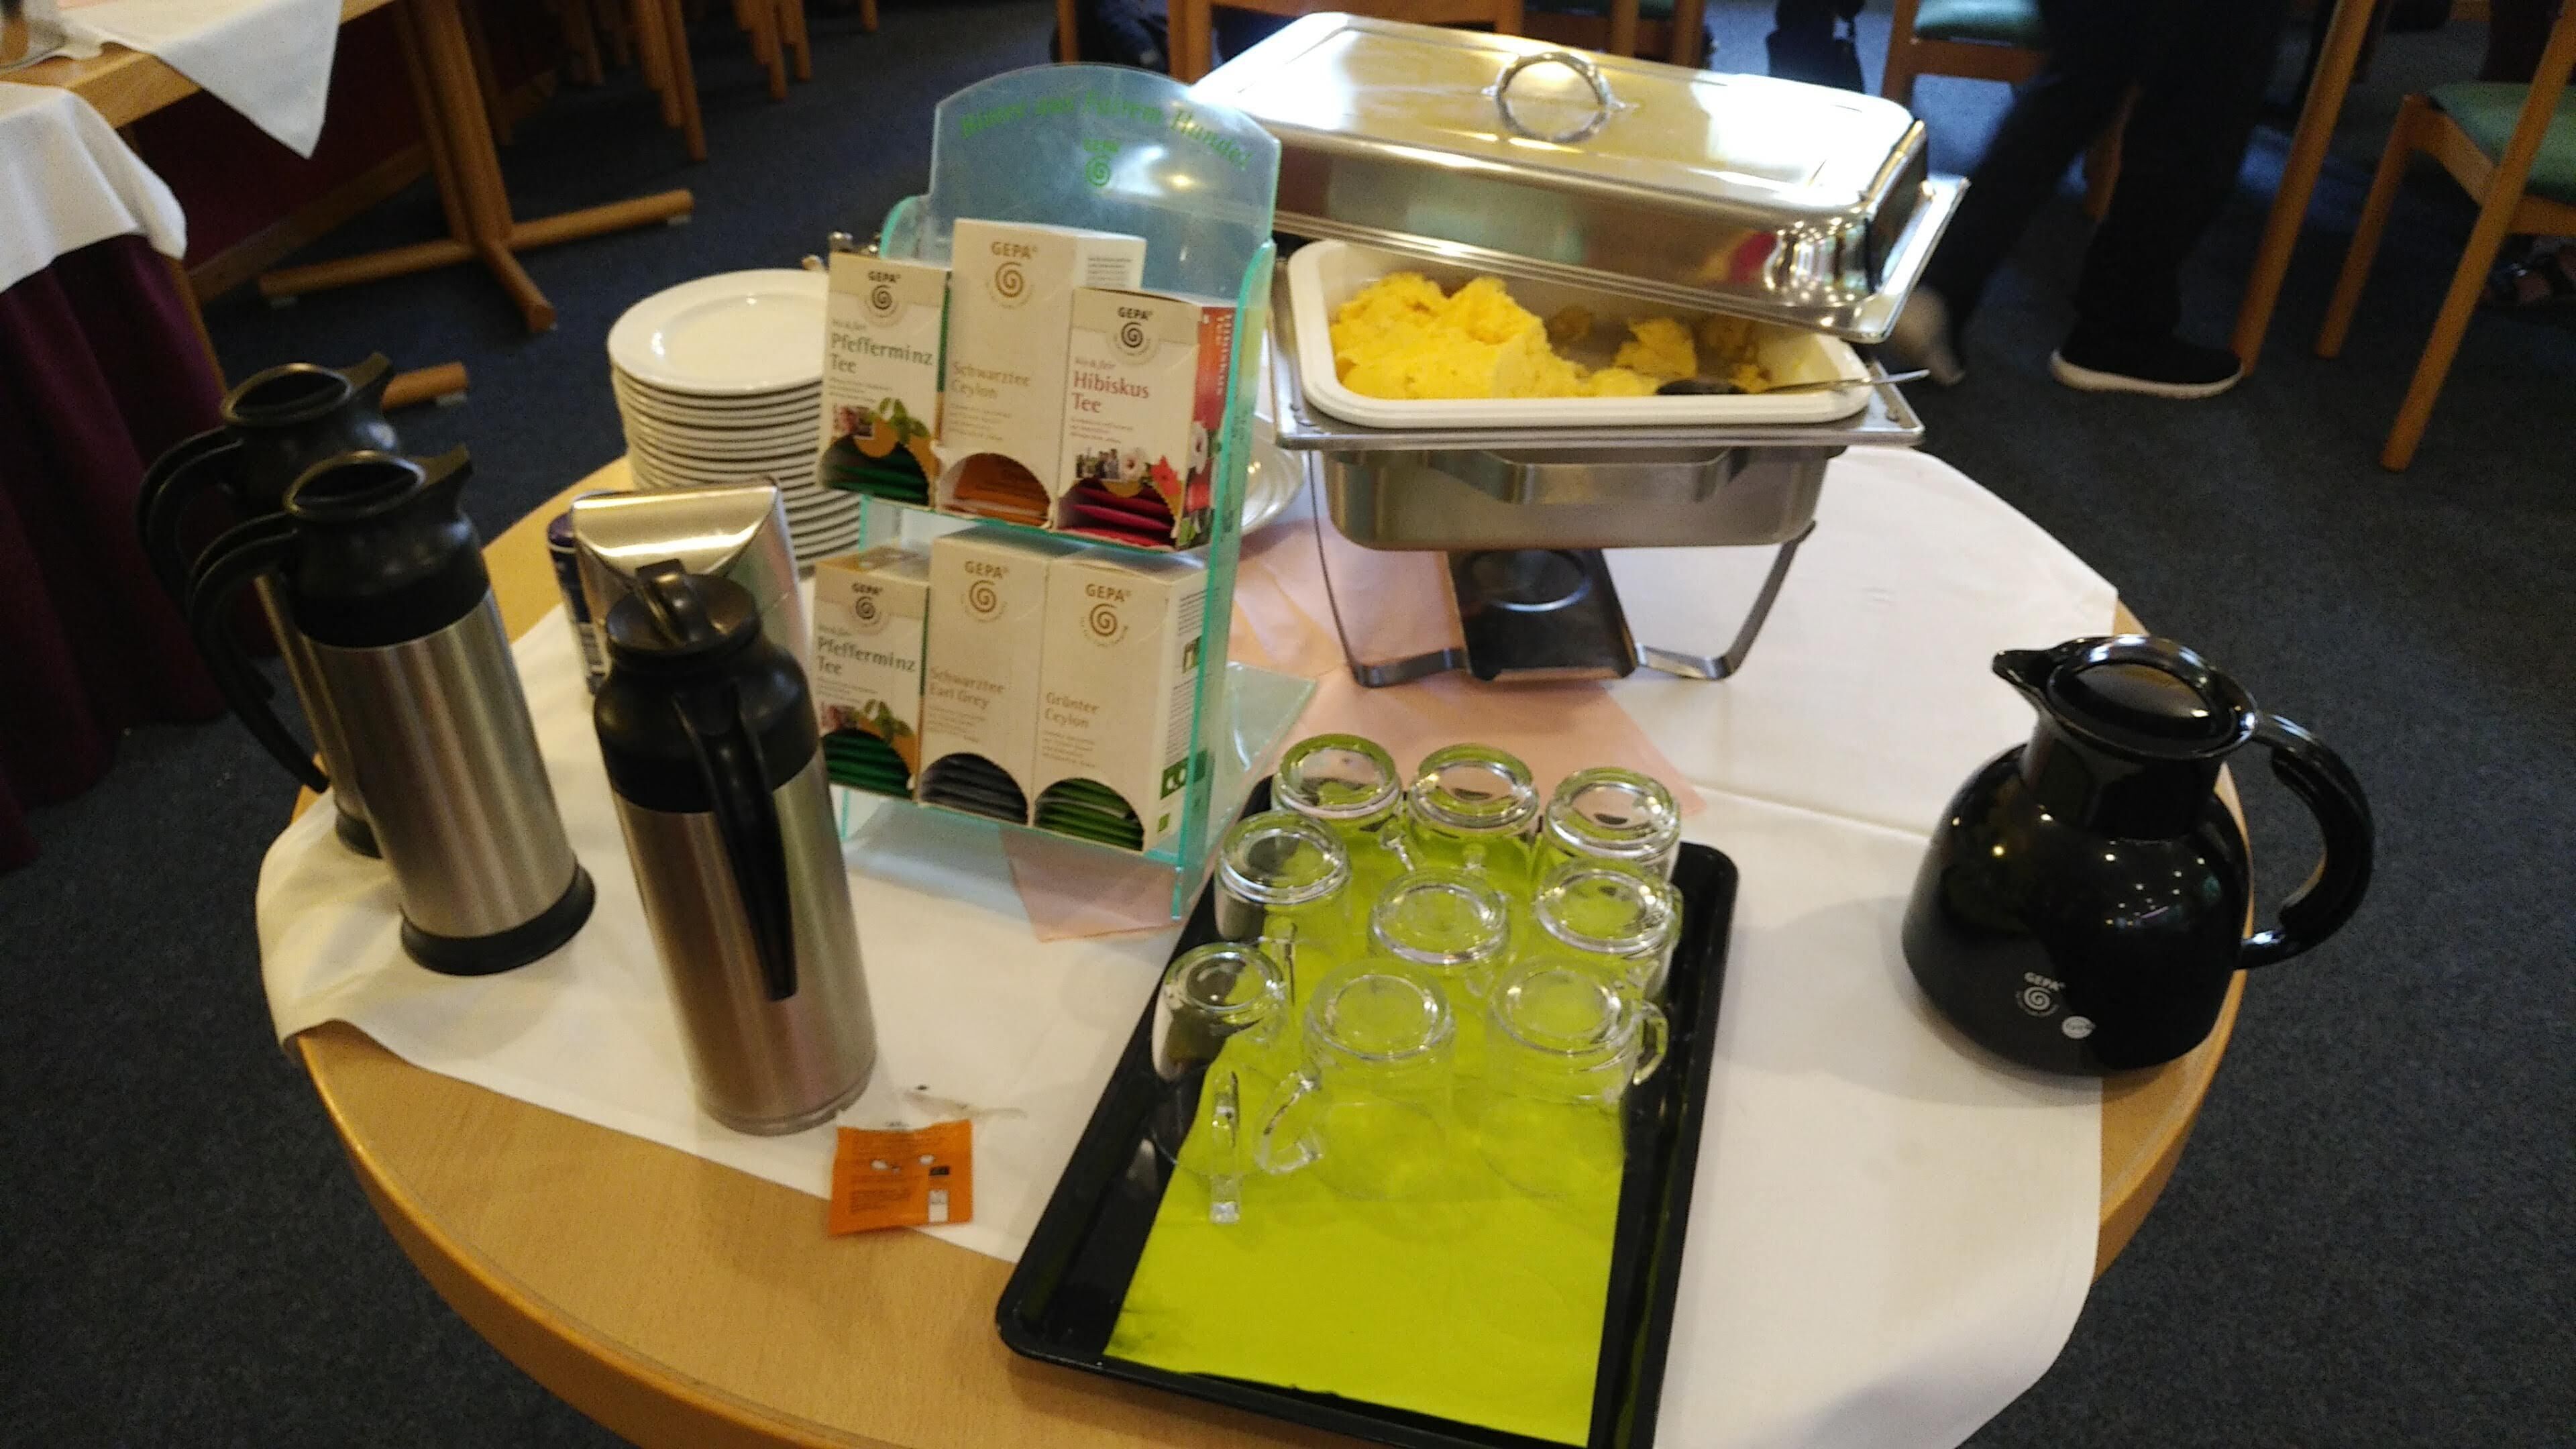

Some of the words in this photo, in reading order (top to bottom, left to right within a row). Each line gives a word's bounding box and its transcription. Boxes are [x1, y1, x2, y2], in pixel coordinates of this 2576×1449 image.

[830, 332, 933, 366] Pfefferminz
[830, 353, 857, 374] Tee
[1073, 370, 1150, 399] Hibiskus
[1072, 392, 1102, 413] Tee
[817, 655, 842, 674] Tee
[818, 637, 916, 672] Pfefferminz
[1044, 708, 1089, 729] Ceylon
